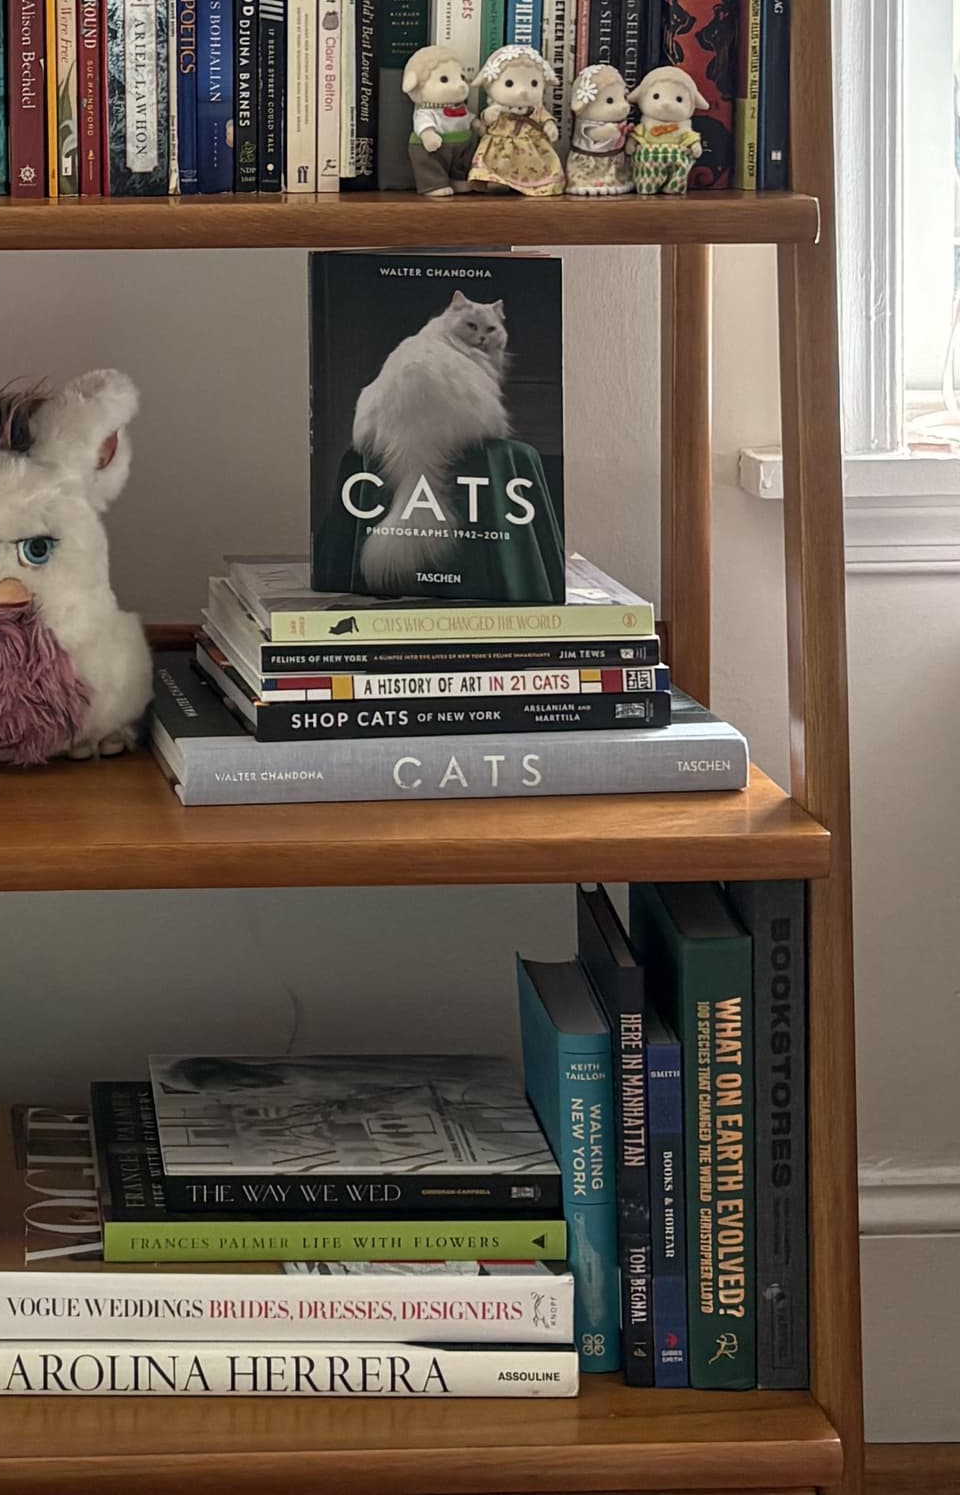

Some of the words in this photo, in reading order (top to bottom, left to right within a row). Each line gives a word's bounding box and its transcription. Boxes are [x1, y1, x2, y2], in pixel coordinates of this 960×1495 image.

[325, 37, 335, 70] Claire
[325, 74, 335, 111] Belton
[380, 268, 421, 276] WALTER
[426, 269, 491, 278] CHANDOHA
[341, 472, 536, 525] CATS
[366, 527, 448, 537] PHOTOGRAPHS
[416, 572, 461, 583] TASCHEN
[271, 655, 305, 663] FELINES
[308, 655, 320, 663] OF
[323, 655, 340, 663] NEW
[343, 654, 368, 663] YORK
[560, 650, 576, 659] JIM
[580, 650, 605, 658] TEWS
[364, 680, 372, 695] A
[378, 678, 434, 694] HISTORY
[439, 678, 455, 692] OF
[461, 678, 482, 691] ART
[490, 677, 504, 691] IN
[510, 675, 527, 690] 21
[532, 674, 570, 690] CATS
[292, 713, 348, 728] SHOP
[358, 710, 408, 726] CATS
[418, 713, 435, 723] OF
[438, 712, 466, 722] NEW
[469, 711, 501, 721] YORK
[393, 753, 542, 789] CATS
[715, 997, 742, 1065] WHAT
[715, 1073, 742, 1106] ON
[716, 1115, 743, 1192] EARTH
[186, 1184, 234, 1203] THE
[242, 1184, 293, 1203] WAY
[300, 1184, 338, 1202] WE
[345, 1183, 401, 1202] WED
[130, 1236, 210, 1250] FRANCES
[218, 1236, 289, 1250] PALMER
[302, 1236, 342, 1250] LIFE
[352, 1236, 402, 1248] WITH
[413, 1236, 501, 1248] FLOWERS
[717, 1199, 745, 1318] EVOLVED?
[7, 1296, 80, 1318] VOGUE
[84, 1298, 204, 1319] WEDDINGS
[209, 1299, 294, 1322] BRIDES,
[298, 1300, 397, 1323] DRESSES,
[400, 1300, 523, 1322] DESIGNERS
[228, 1355, 451, 1394] HERRERA
[498, 1371, 560, 1383] ASSOULINE
